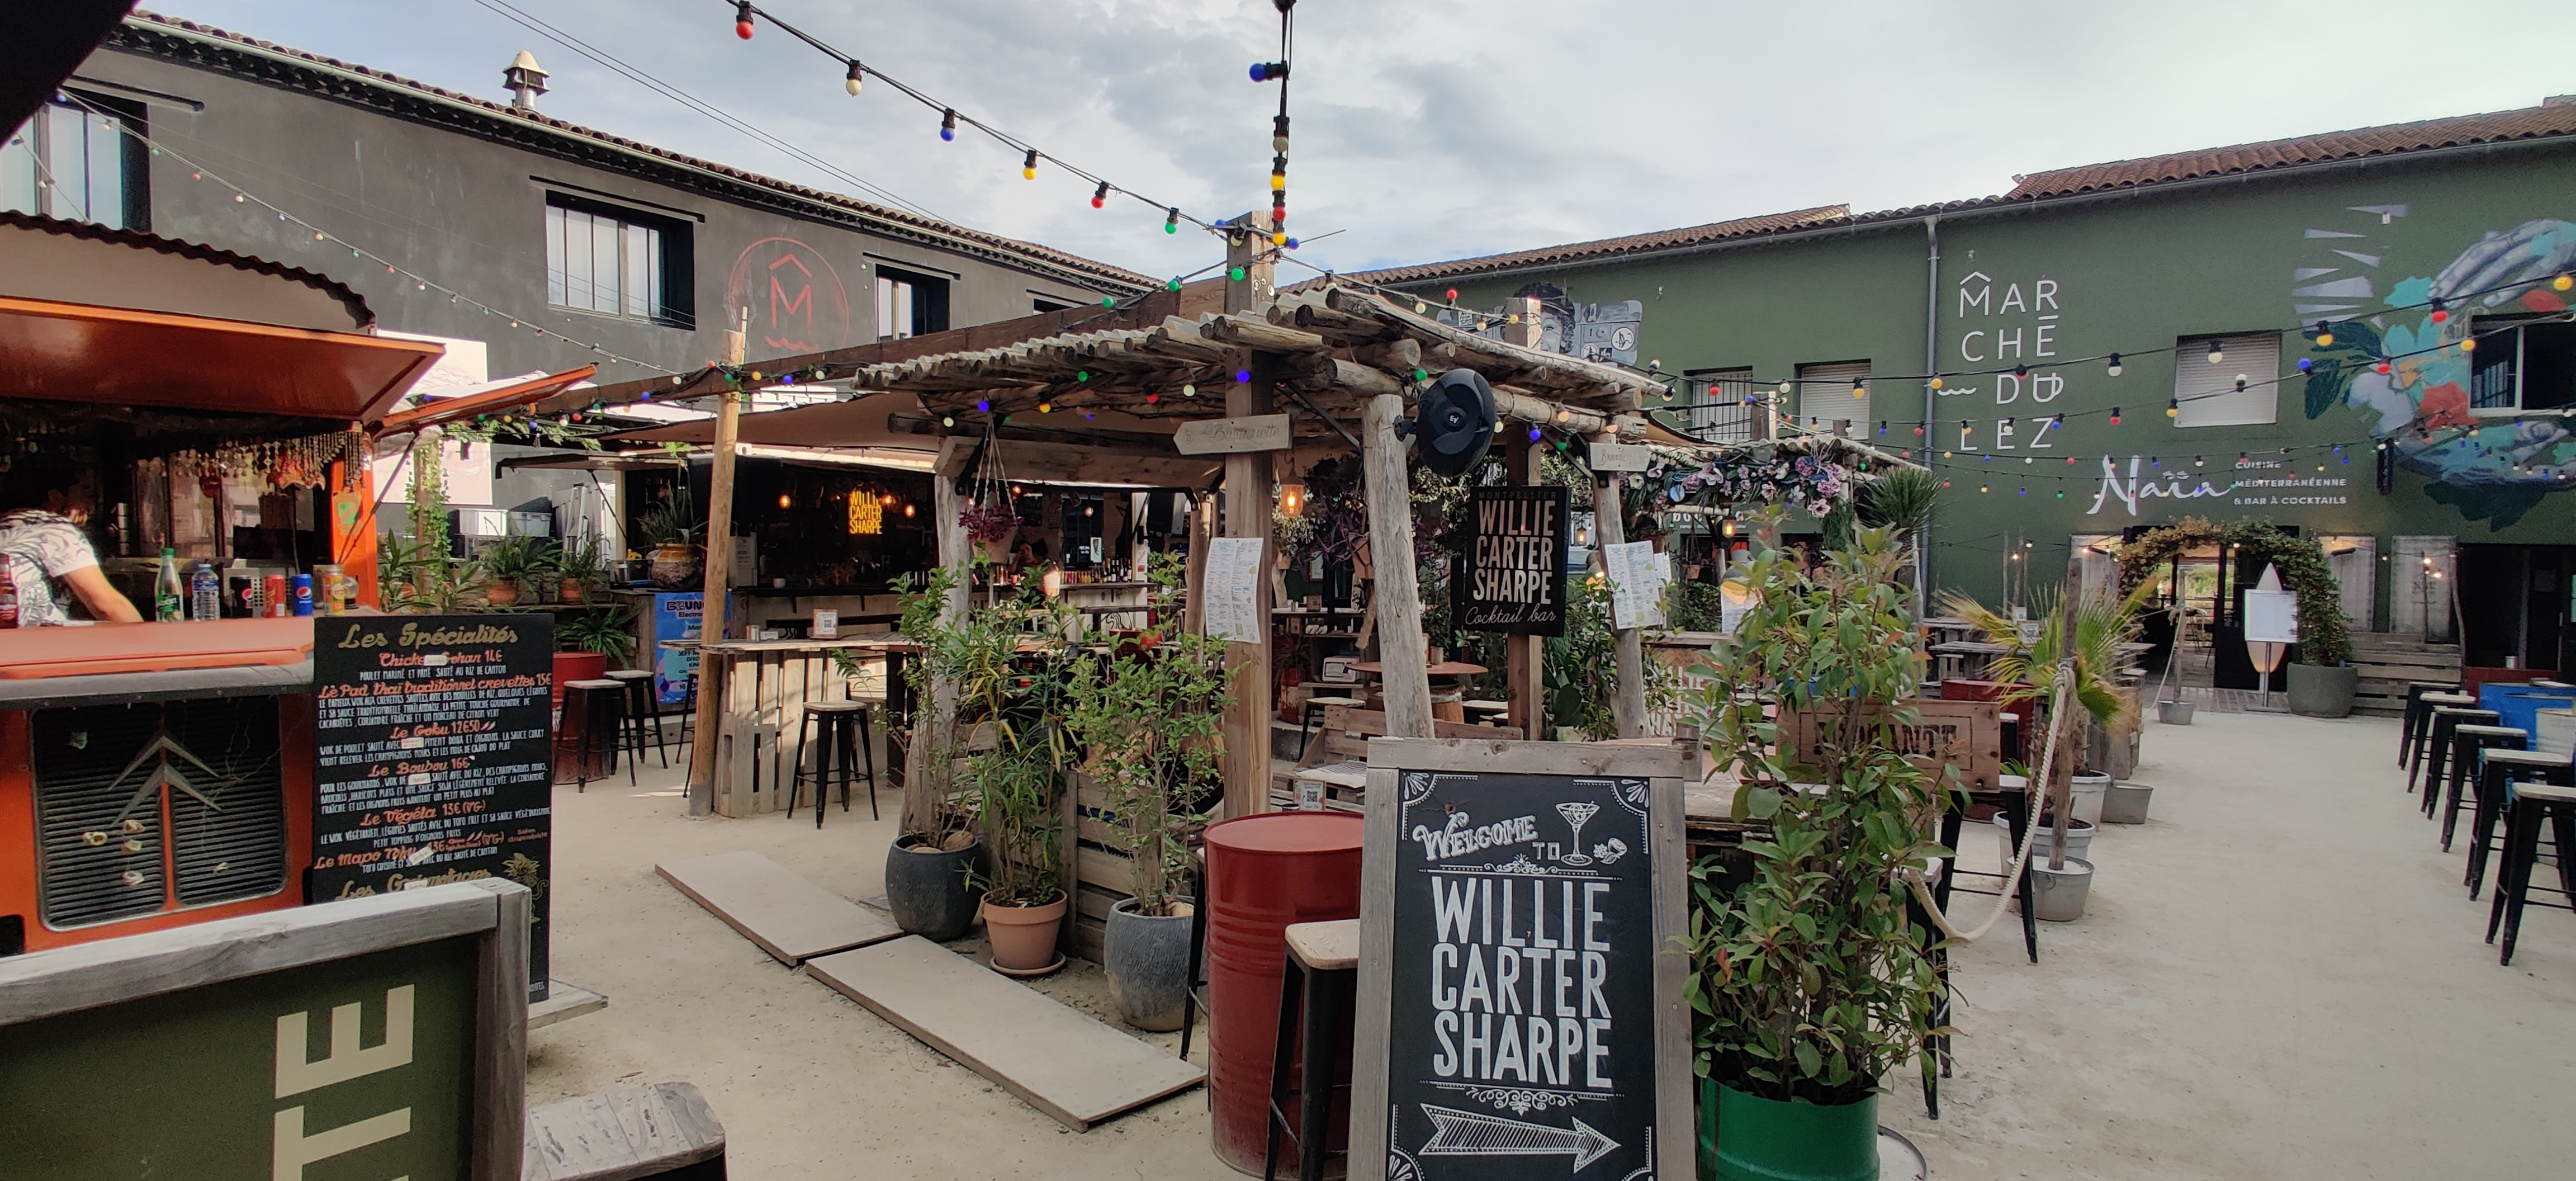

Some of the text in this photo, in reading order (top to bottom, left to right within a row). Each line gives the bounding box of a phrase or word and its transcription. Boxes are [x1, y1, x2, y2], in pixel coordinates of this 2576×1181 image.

[1959, 272, 2059, 318] MAR
[1996, 372, 2064, 404] DU
[1961, 417, 2054, 451] LEZ
[2235, 477, 2347, 488] MÉDITERRANÉENNE
[850, 506, 882, 520] CARTER
[2281, 496, 2347, 504] COCKTAILS
[850, 520, 882, 534] SHARPE
[1479, 500, 1556, 536] WILLIE
[1476, 535, 1553, 570] CARTER
[1473, 568, 1552, 604] SHARPE
[667, 601, 703, 611] BRUN
[1465, 603, 1556, 625] Cocktail bar
[338, 622, 518, 650] Les Spécialités
[379, 650, 425, 667] Chicke
[340, 683, 370, 697] Pad
[404, 678, 476, 693] traditionnel
[536, 673, 552, 686] 15€
[359, 670, 381, 681] POULET
[383, 668, 405, 680] MARINÉ
[408, 670, 415, 678] ET
[435, 665, 453, 677] SAUTÉ
[456, 667, 463, 676] AU
[466, 665, 475, 675] RIZ
[477, 665, 483, 675] DE
[485, 664, 506, 674] CANTON
[319, 687, 524, 708] LE FAMEUX CREVETTES DES DE QUELQUES
[319, 710, 326, 719] ET
[337, 708, 355, 717] SAUCE
[357, 706, 401, 717] TRADITIONNELLE
[469, 700, 489, 709] TOUCHE
[490, 698, 521, 708] GOURMANDE
[415, 714, 422, 722] ET
[458, 711, 465, 719] DE
[466, 710, 485, 719] CITRON
[487, 708, 500, 717] VERT
[389, 719, 480, 739] Le Goku 12€50
[320, 745, 334, 756] WOK
[335, 744, 342, 754] DE
[344, 743, 364, 754] POULET
[367, 740, 385, 751] SAUTÉ
[386, 740, 400, 750] AVEC
[425, 736, 446, 747] PIMENT
[448, 735, 463, 744] DOUX
[466, 734, 473, 744] ET
[503, 731, 510, 741] LA
[510, 730, 527, 740] SAUCE
[528, 729, 544, 738] CURRY
[320, 741, 511, 767] VIENT RELEVER LES CHAMPIGNONS NOIRS LES DE CAJOU DU PLAT
[320, 783, 335, 793] POUR
[337, 782, 347, 792] LES
[347, 779, 380, 791] GOURMANDS
[385, 777, 397, 786] WOK
[399, 776, 406, 785] DE
[432, 772, 448, 782] SAUTÉ
[449, 770, 462, 780] AVEC
[464, 769, 472, 779] DU
[485, 767, 495, 776] DES
[495, 763, 530, 774] CHAMPIGNONS
[367, 764, 390, 777] Le
[396, 760, 449, 775] Boubou
[349, 786, 495, 811] ET LES AJOUTENT PETIT PLUS AU PLAT
[379, 775, 517, 798] PLATS ET SAUCE SOJA LA
[359, 812, 382, 826] Le
[442, 802, 461, 816] 13€
[462, 799, 486, 814] (VG)
[320, 811, 513, 845] LE WOK LÉGUMES SAUTÉS DU TOFU FRIT ET SAUCE
[373, 829, 461, 848] PETIT TOPPING FRITS
[1413, 811, 1560, 861] WELCOME TO
[313, 856, 335, 870] Le
[338, 851, 382, 867] Mapo
[482, 830, 505, 846] (VG)
[362, 846, 498, 874] TOFU DU SAUTÉ DE CANTON
[1431, 876, 1611, 952] WILLIE
[1431, 943, 1612, 1019] CARTER
[1433, 1010, 1613, 1088] SHARPE
[273, 984, 415, 1181] TE
